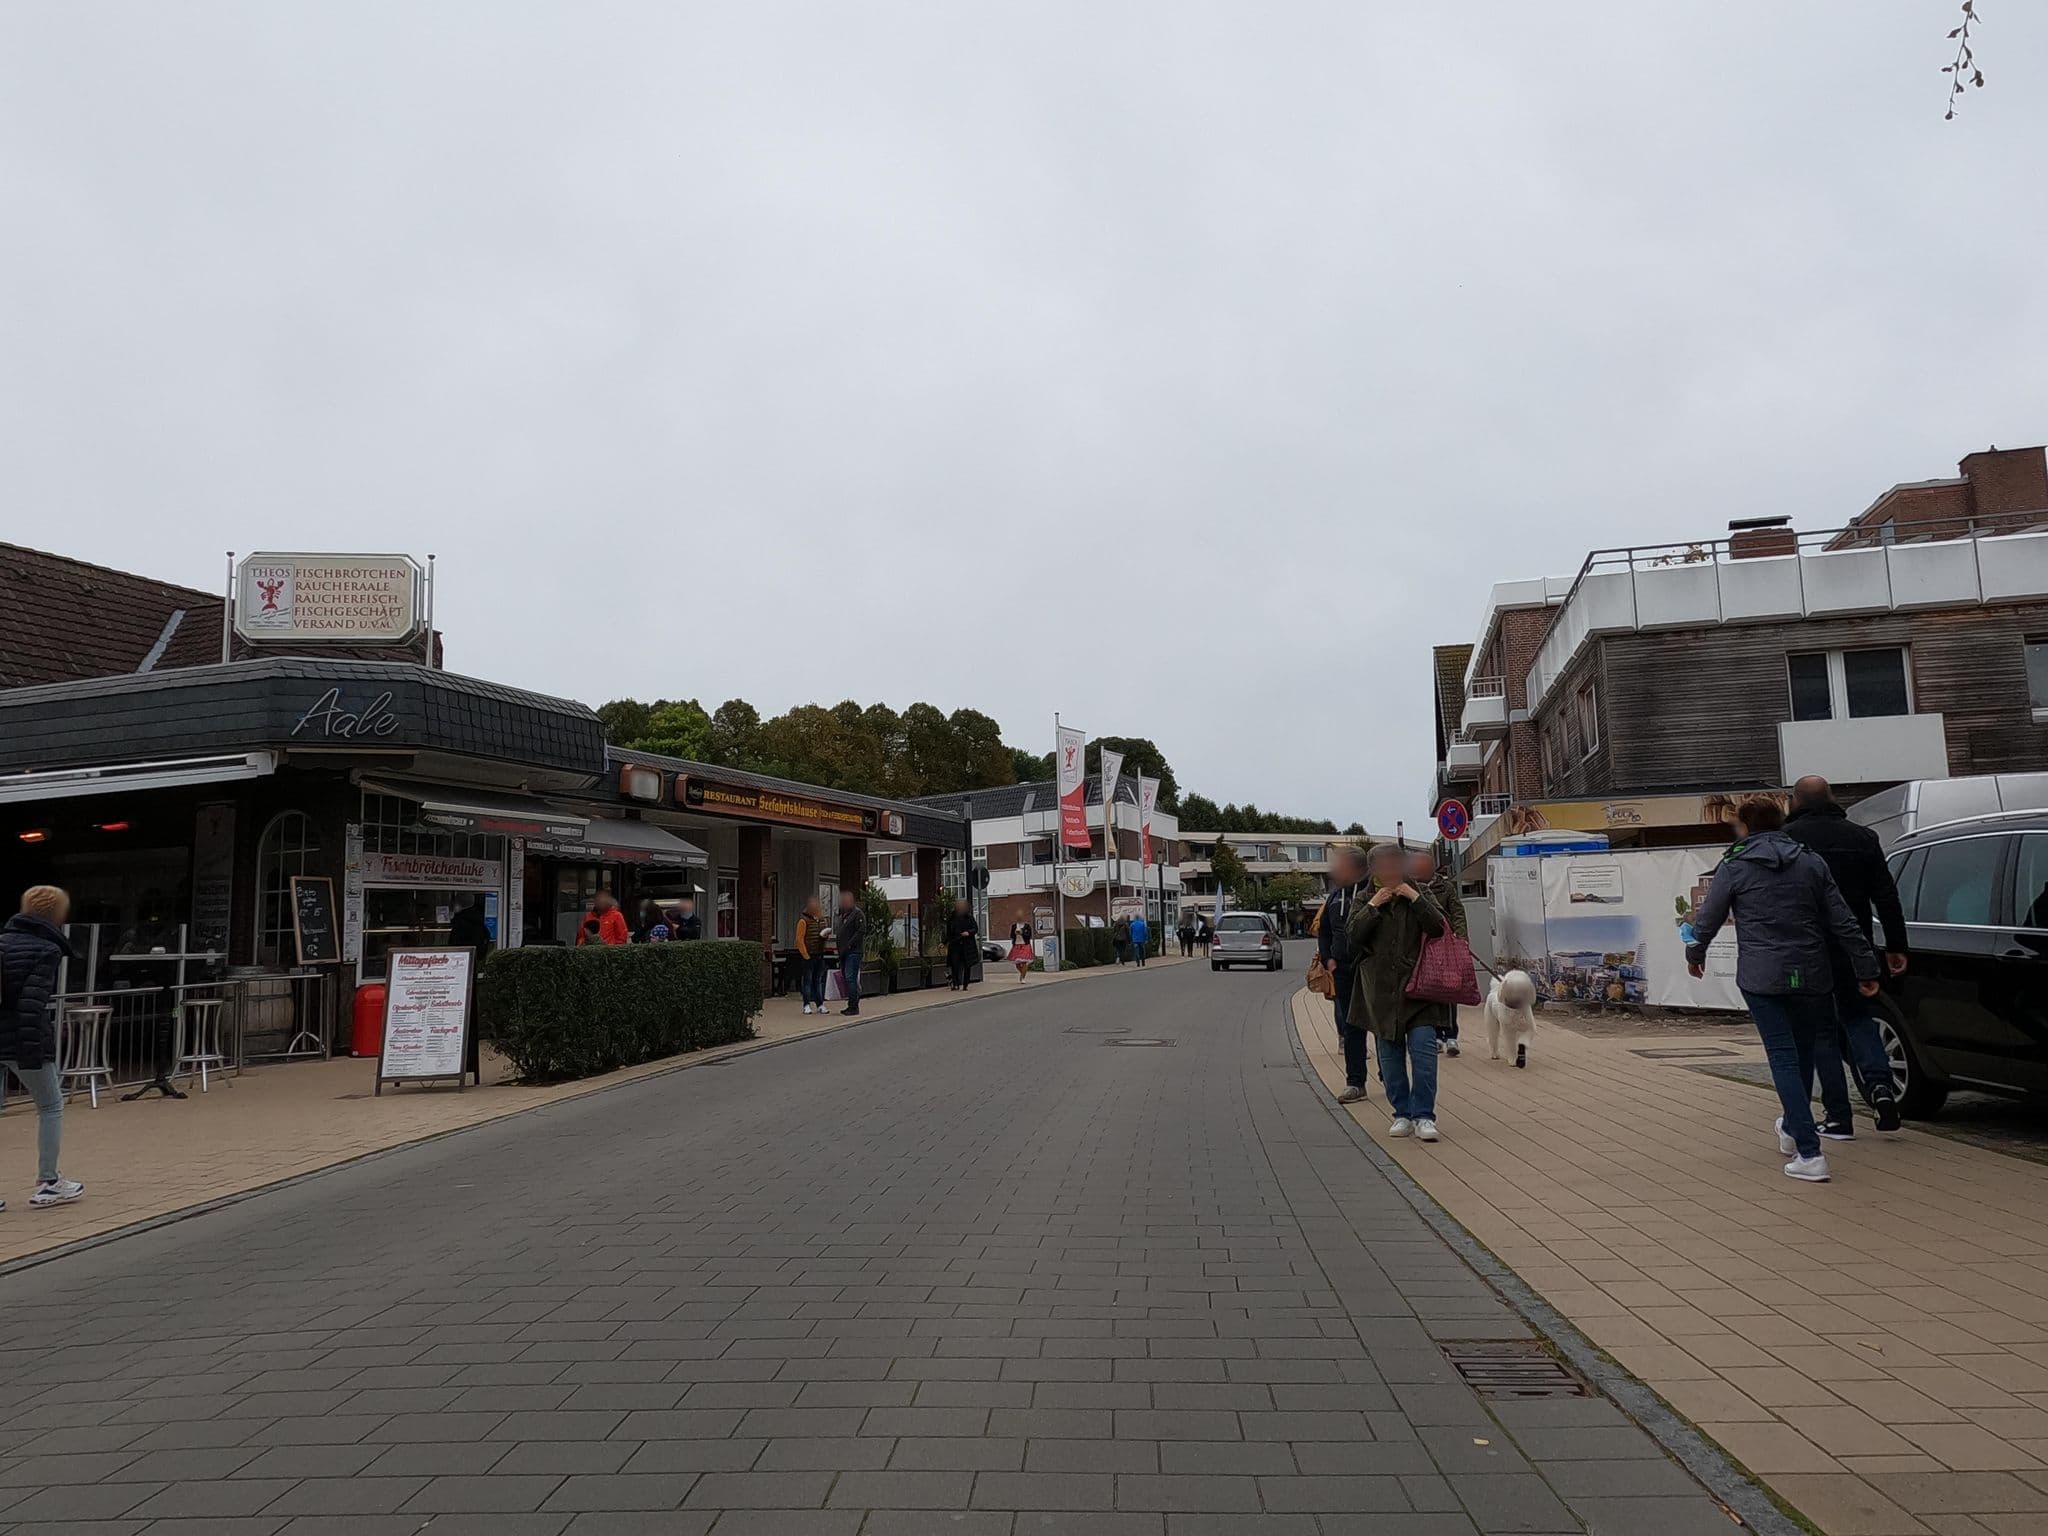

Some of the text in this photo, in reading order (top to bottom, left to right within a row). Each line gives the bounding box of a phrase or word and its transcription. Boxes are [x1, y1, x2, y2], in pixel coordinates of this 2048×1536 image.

[251, 568, 291, 578] THEOS
[295, 567, 406, 578] FISCHBRÖTCHEN
[293, 619, 356, 629] VERSAND
[291, 687, 399, 738] Aale
[703, 789, 757, 807] RESTAURANT
[759, 795, 818, 818] Seefahrtsklause
[381, 855, 484, 877] Fischbrötchenluke
